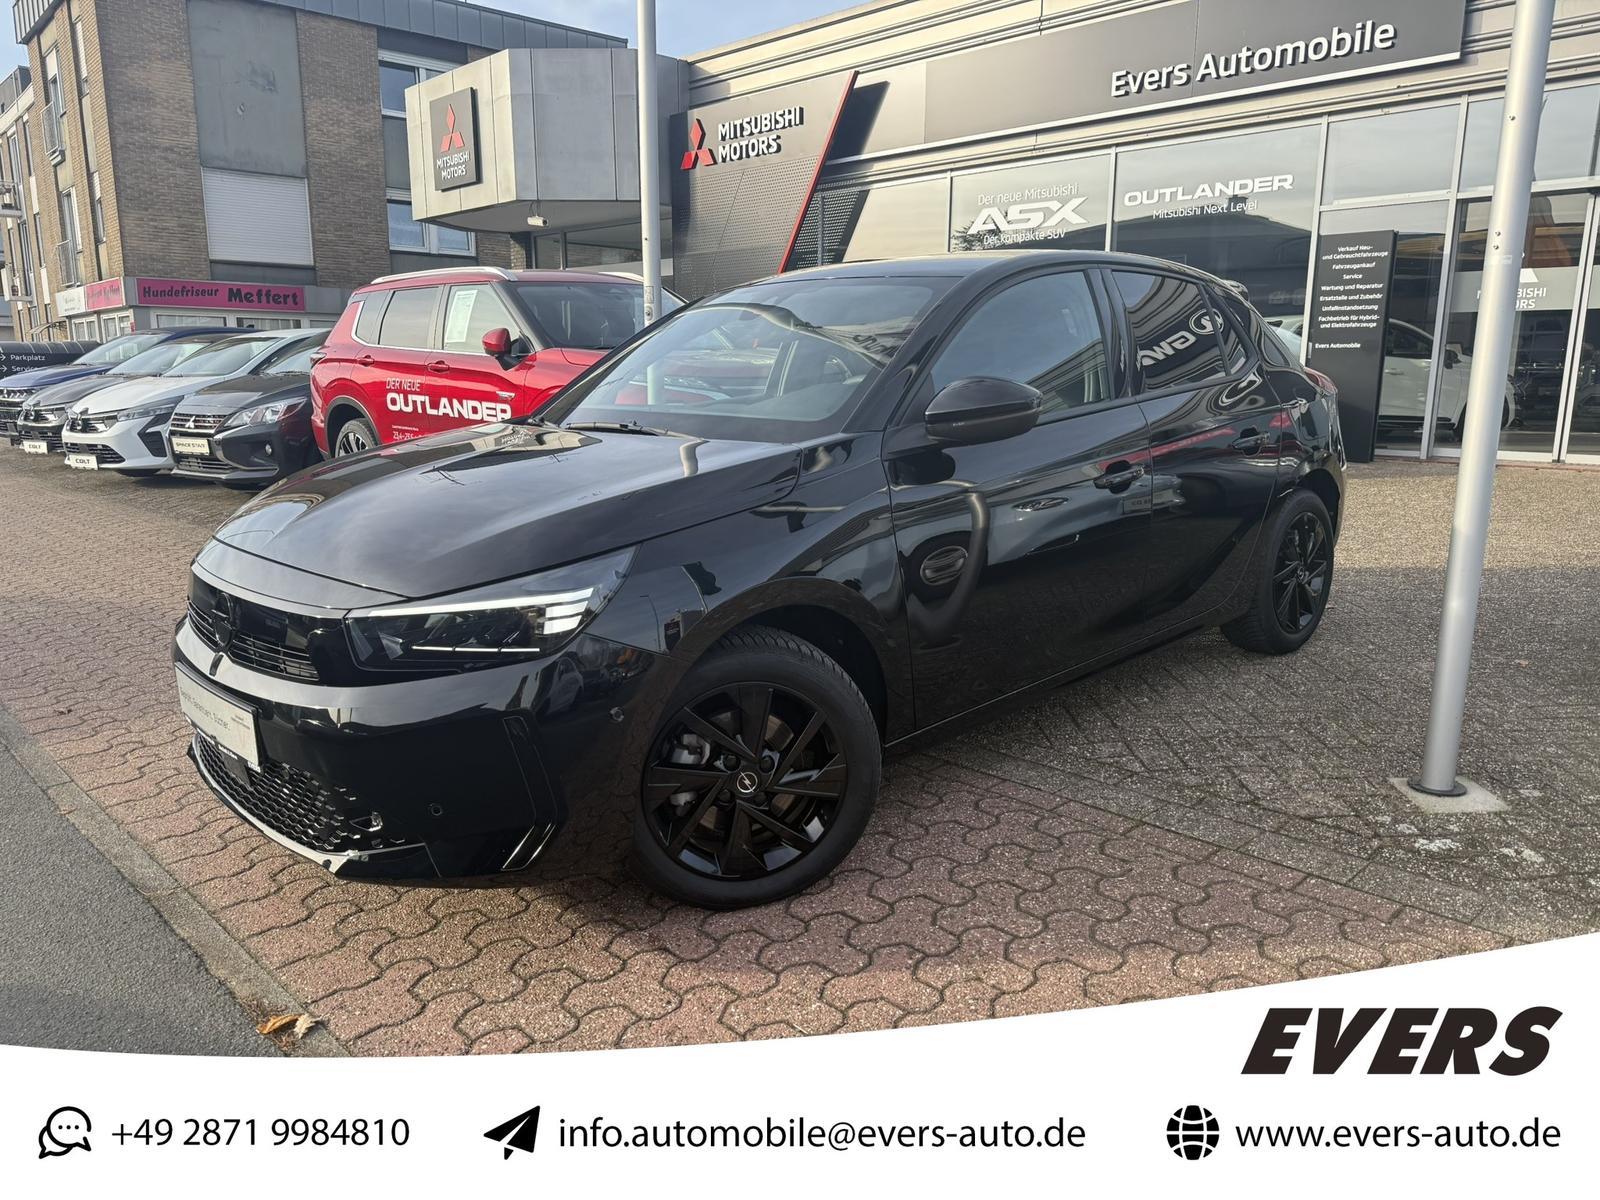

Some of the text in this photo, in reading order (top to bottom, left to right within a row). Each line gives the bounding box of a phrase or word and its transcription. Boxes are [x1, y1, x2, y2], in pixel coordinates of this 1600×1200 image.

[1110, 20, 1397, 97] Evers Automobile
[718, 105, 802, 141] MITSUBISHI
[718, 134, 779, 163] MOTORS
[437, 151, 470, 169] MITSUBISHI
[441, 164, 466, 180] MOTORS
[978, 183, 1079, 205] Der neue Mitsubishi
[1124, 174, 1295, 207] OUTLANDER
[967, 196, 1090, 235] ASX
[1153, 199, 1258, 219] Mitsubishi Next Level
[983, 228, 1067, 246] Der kompakte SUV
[1333, 251, 1389, 260] Gebrauchtfahrzeuge
[1338, 244, 1359, 252] Verkauf
[1332, 261, 1376, 270] Fahrzeugankauf
[143, 286, 299, 306] Hundefriseur Meffert
[1320, 284, 1344, 292] Wartung
[1356, 282, 1384, 290] Reparatur
[1321, 304, 1379, 312] Unfallinstandsetzung
[10, 354, 46, 362] Parkplatz
[386, 378, 421, 391] DER NEUE
[386, 392, 512, 423] OUTLANDER
